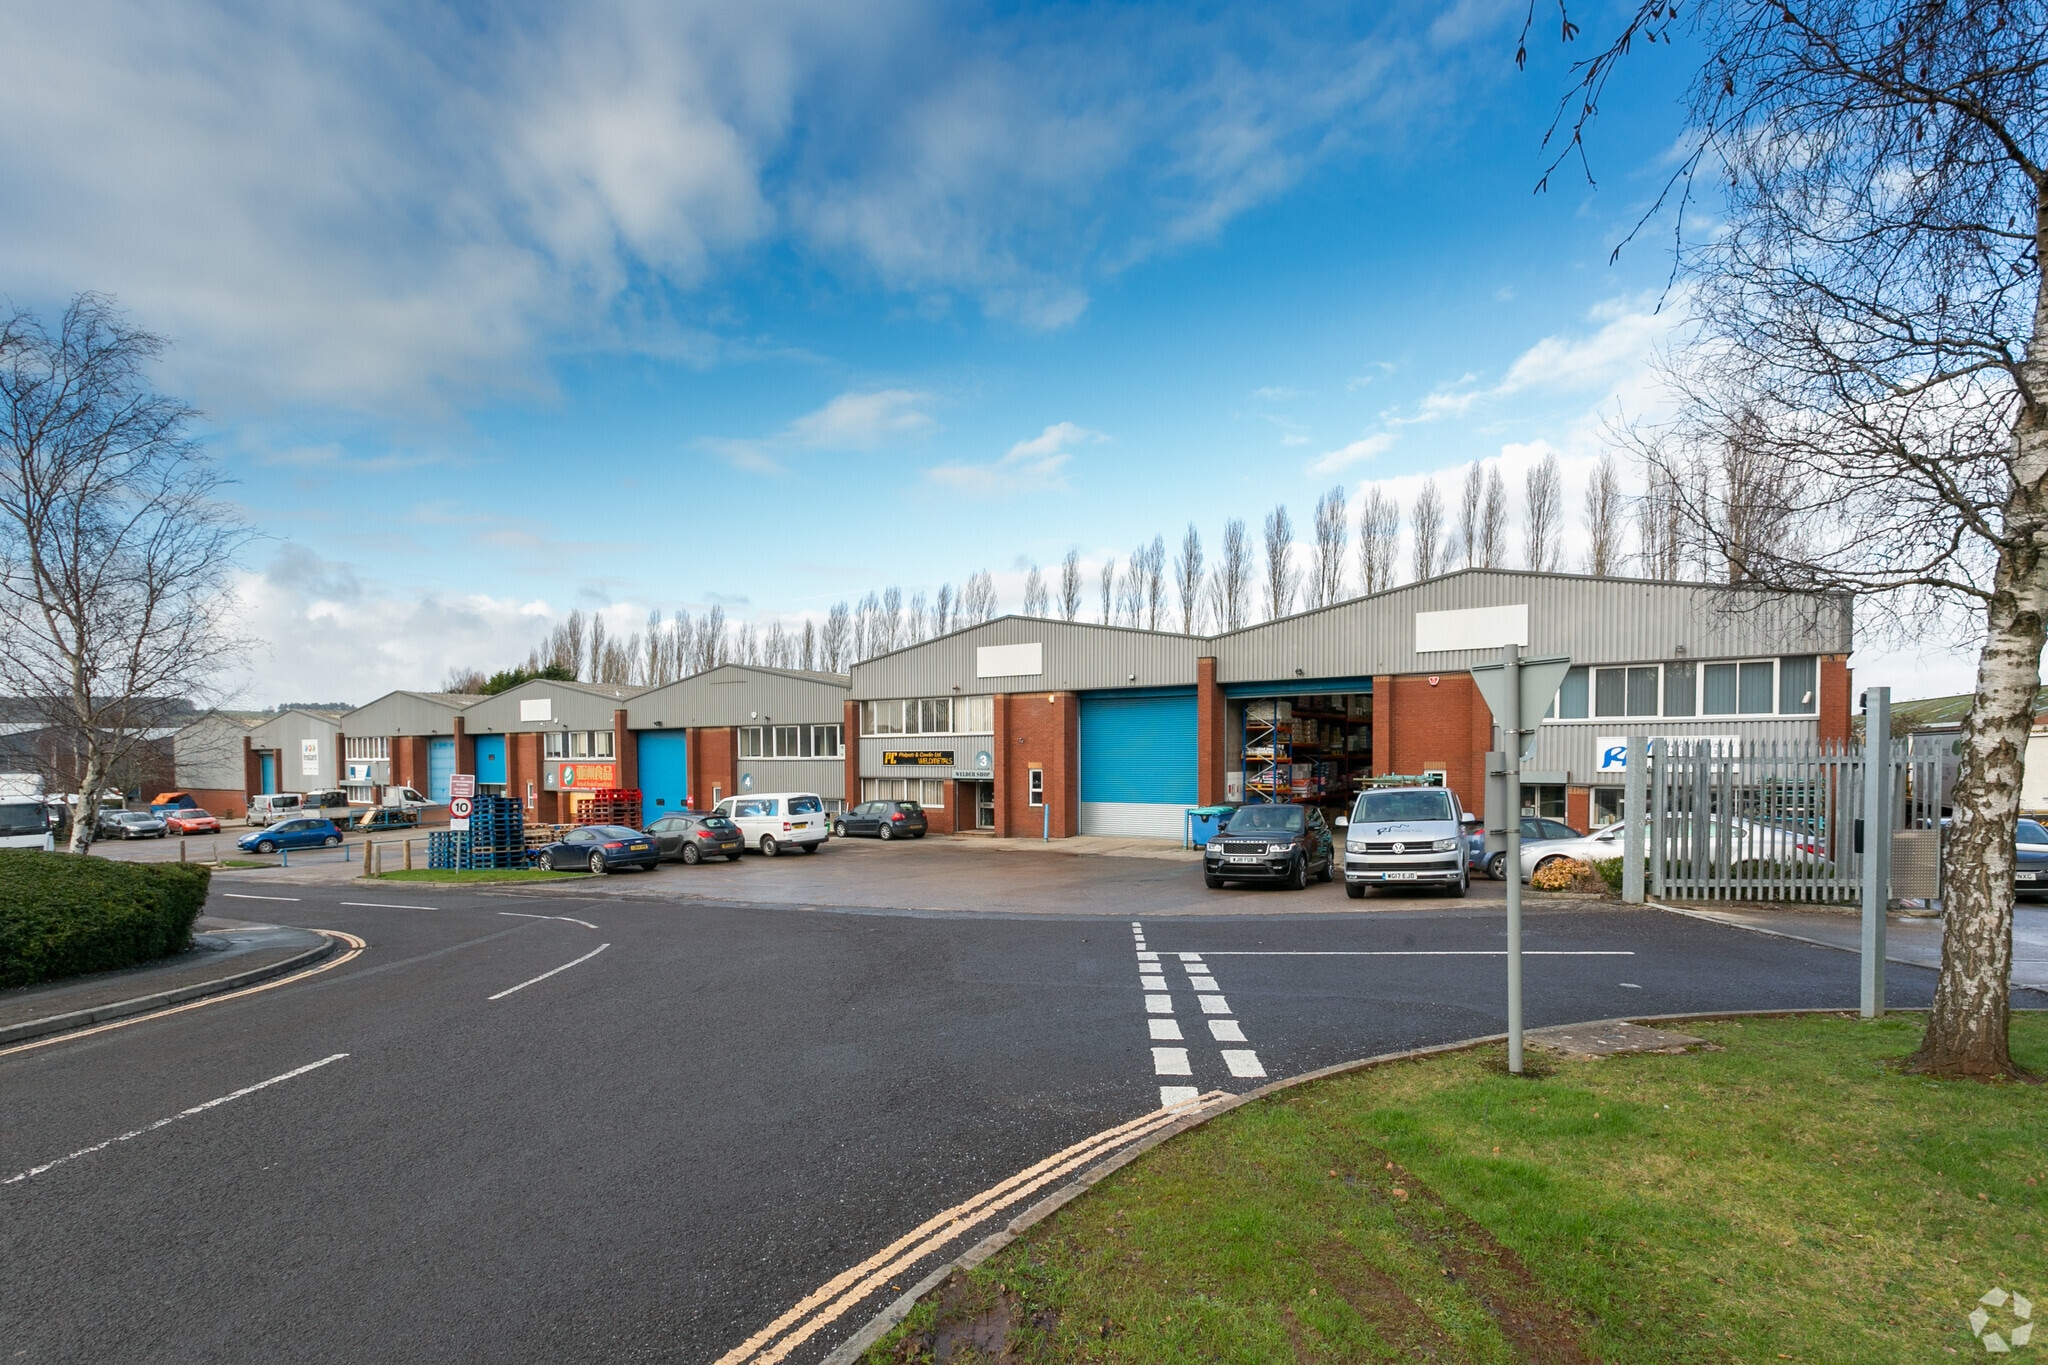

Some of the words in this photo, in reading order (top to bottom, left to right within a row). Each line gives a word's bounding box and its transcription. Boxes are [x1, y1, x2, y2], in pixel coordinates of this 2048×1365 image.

[884, 752, 898, 765] PC
[979, 755, 988, 767] 3
[548, 774, 553, 784] 5
[744, 776, 751, 787] 4
[455, 802, 469, 813] 10
